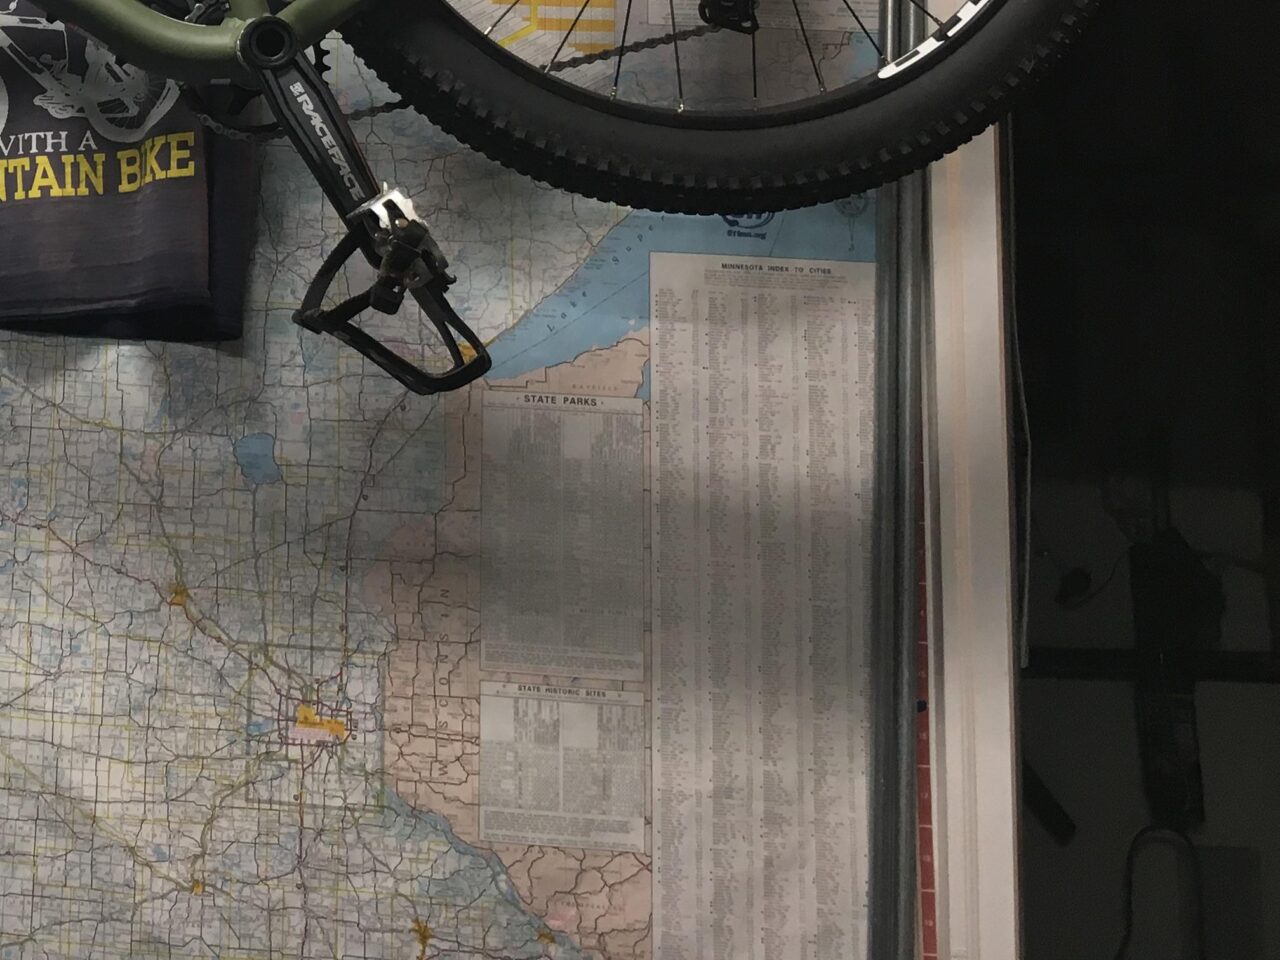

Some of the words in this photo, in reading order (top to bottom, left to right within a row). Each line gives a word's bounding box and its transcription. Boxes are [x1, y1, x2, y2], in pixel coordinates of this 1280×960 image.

[77, 128, 99, 153] A
[117, 130, 196, 194] BIKE
[721, 262, 764, 271] MINNESOTA
[767, 265, 790, 273] INDEX
[809, 267, 832, 275] CITIES
[524, 394, 557, 405] STATE
[562, 396, 598, 407] PARKS
[517, 684, 541, 693] STATE
[545, 687, 581, 697] HISTORIC
[585, 690, 607, 699] SITES
